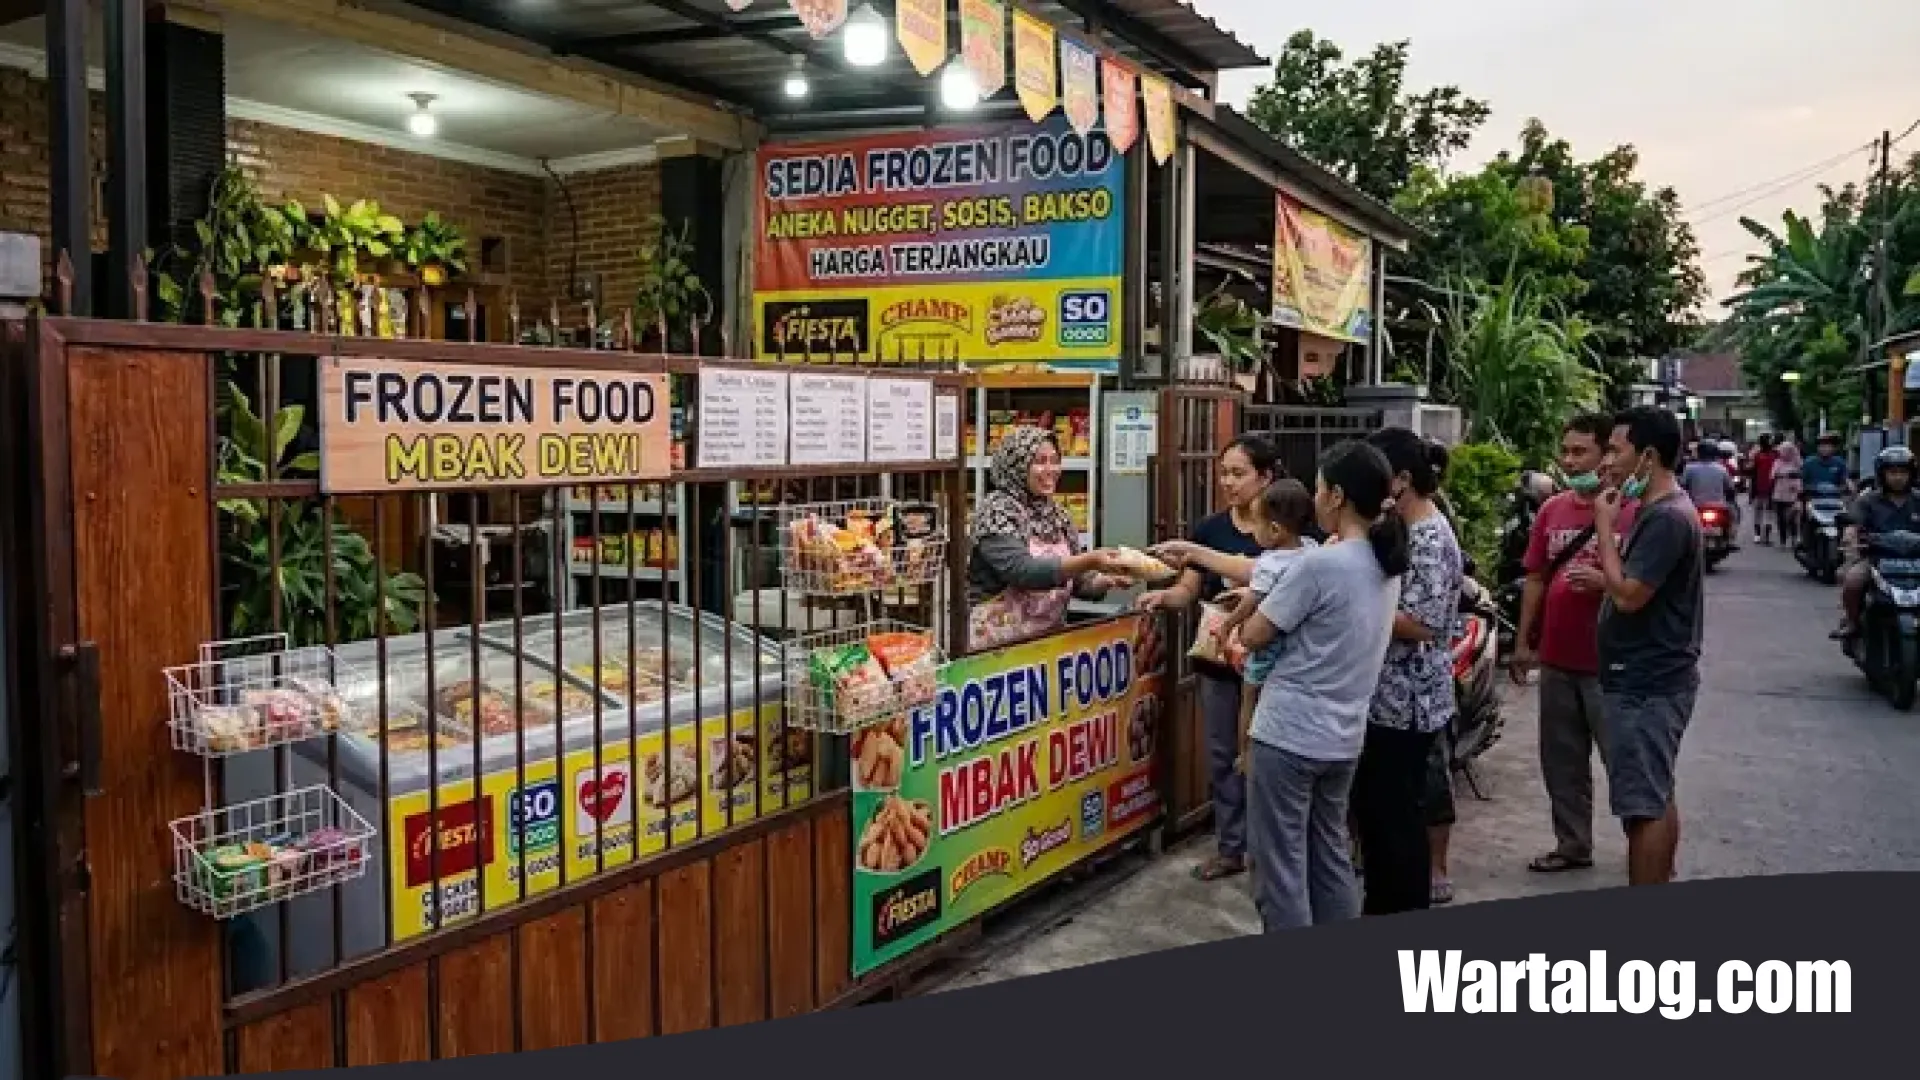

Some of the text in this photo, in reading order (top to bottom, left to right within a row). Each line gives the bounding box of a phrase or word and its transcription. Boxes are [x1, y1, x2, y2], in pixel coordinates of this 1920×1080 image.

[767, 132, 1113, 199] SEDIA FROZEN FOOD
[767, 187, 1112, 238] ANEKA NUGGET, SOSIS, BAKSO
[810, 236, 1050, 279] HARGA TERJANGKAU
[786, 316, 858, 342] FIESTA
[881, 299, 969, 326] CHAMP
[1064, 296, 1105, 320] SO
[344, 370, 535, 424] FROZEN
[552, 378, 655, 424] FOOD
[385, 432, 641, 484] MBAK DEWI
[911, 640, 1132, 765] FROZEN FOOD
[938, 710, 1119, 836] MBAK DEWI
